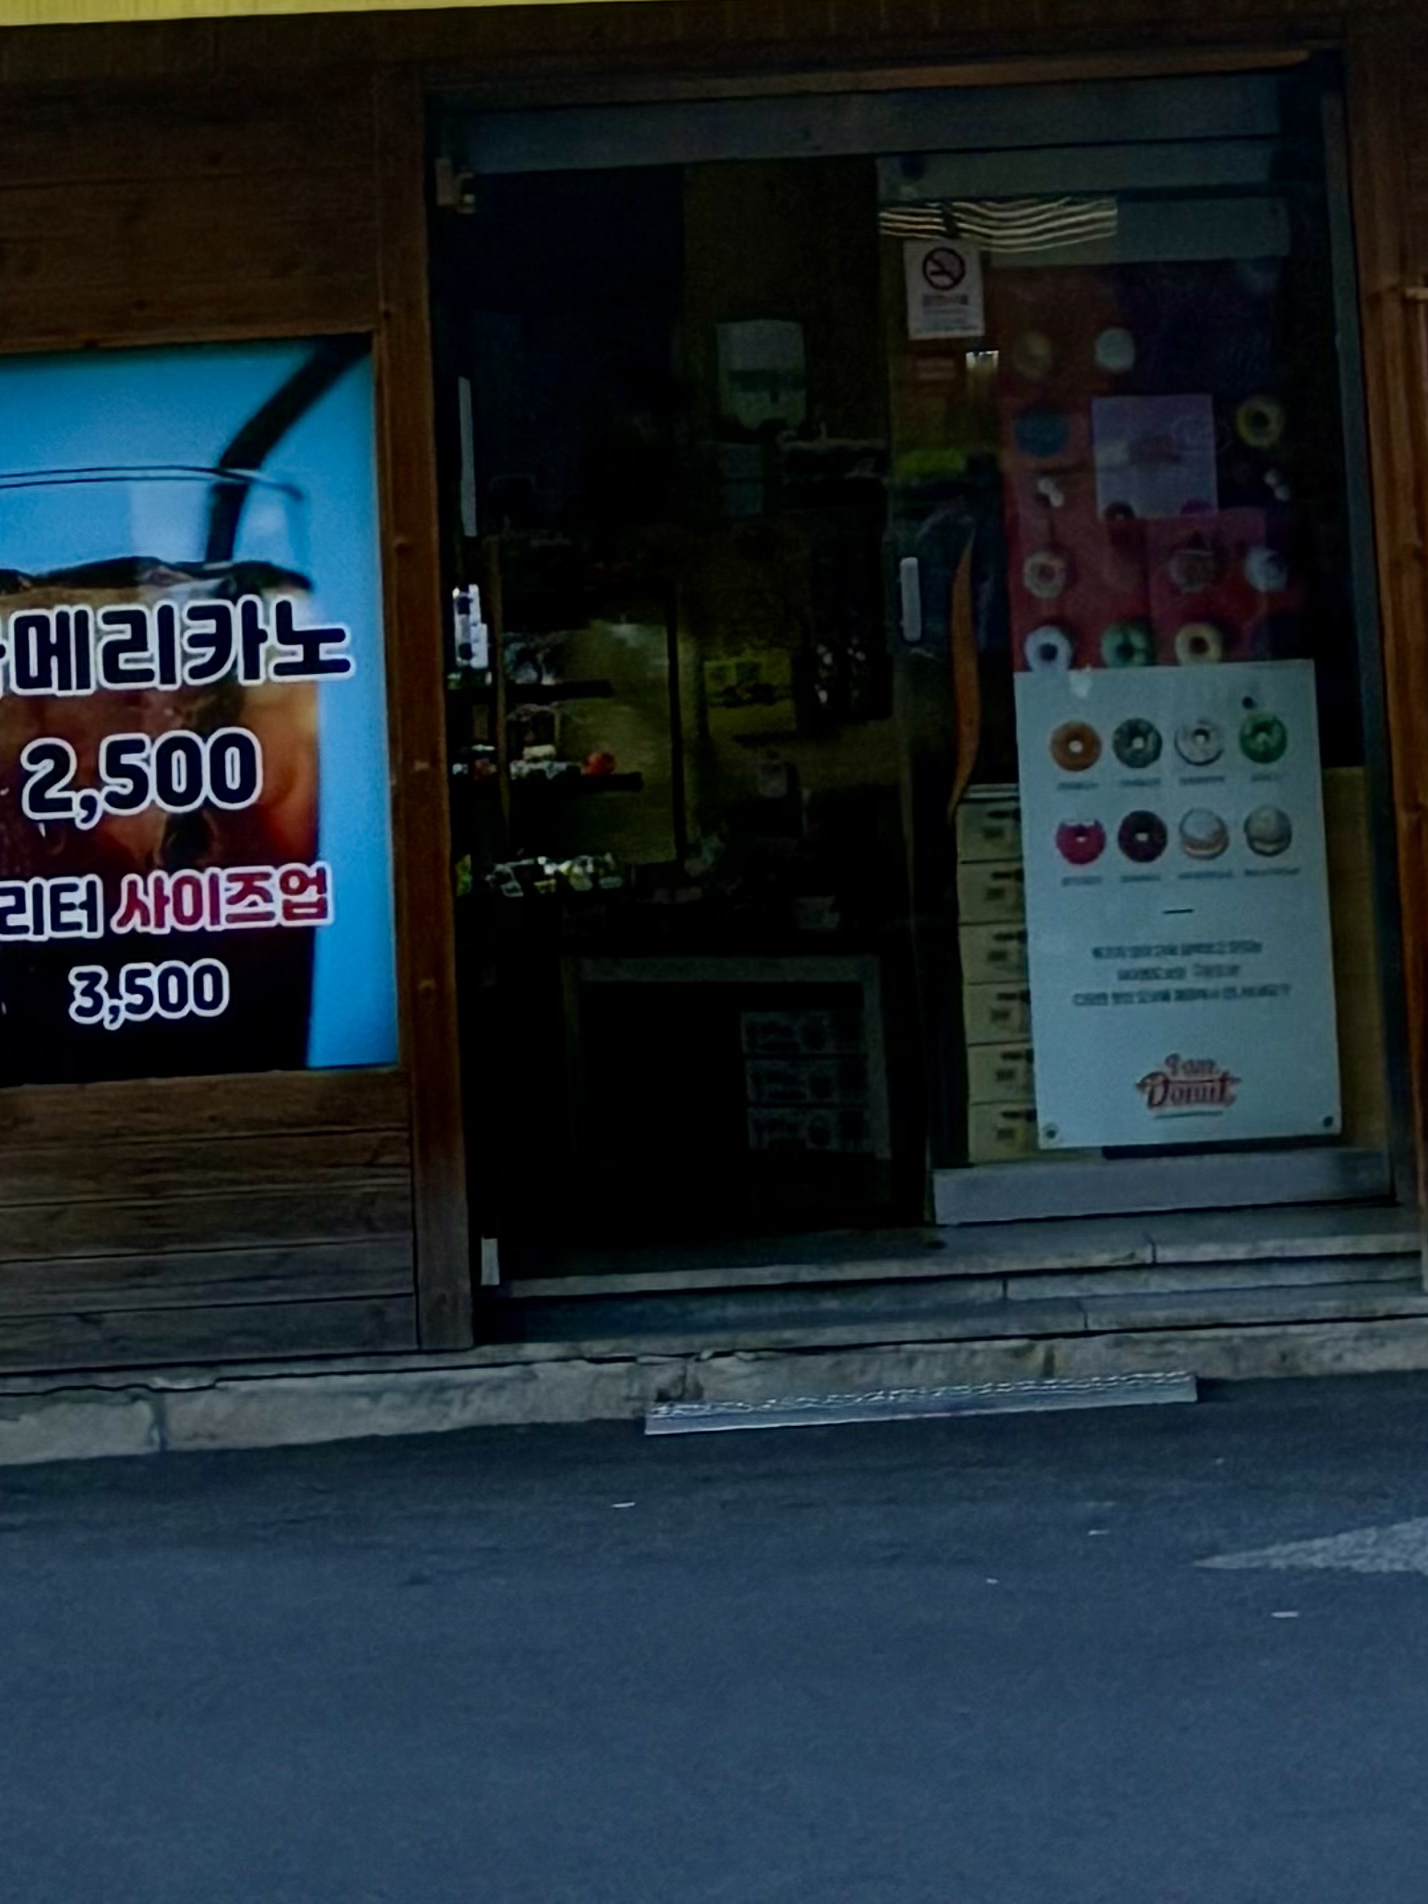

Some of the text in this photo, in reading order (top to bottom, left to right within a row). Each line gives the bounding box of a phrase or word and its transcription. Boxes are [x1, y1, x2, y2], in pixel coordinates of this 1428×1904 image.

[21, 727, 263, 830] 2,500
[110, 861, 334, 937] 사이즈업
[68, 958, 229, 1030] 3,500
